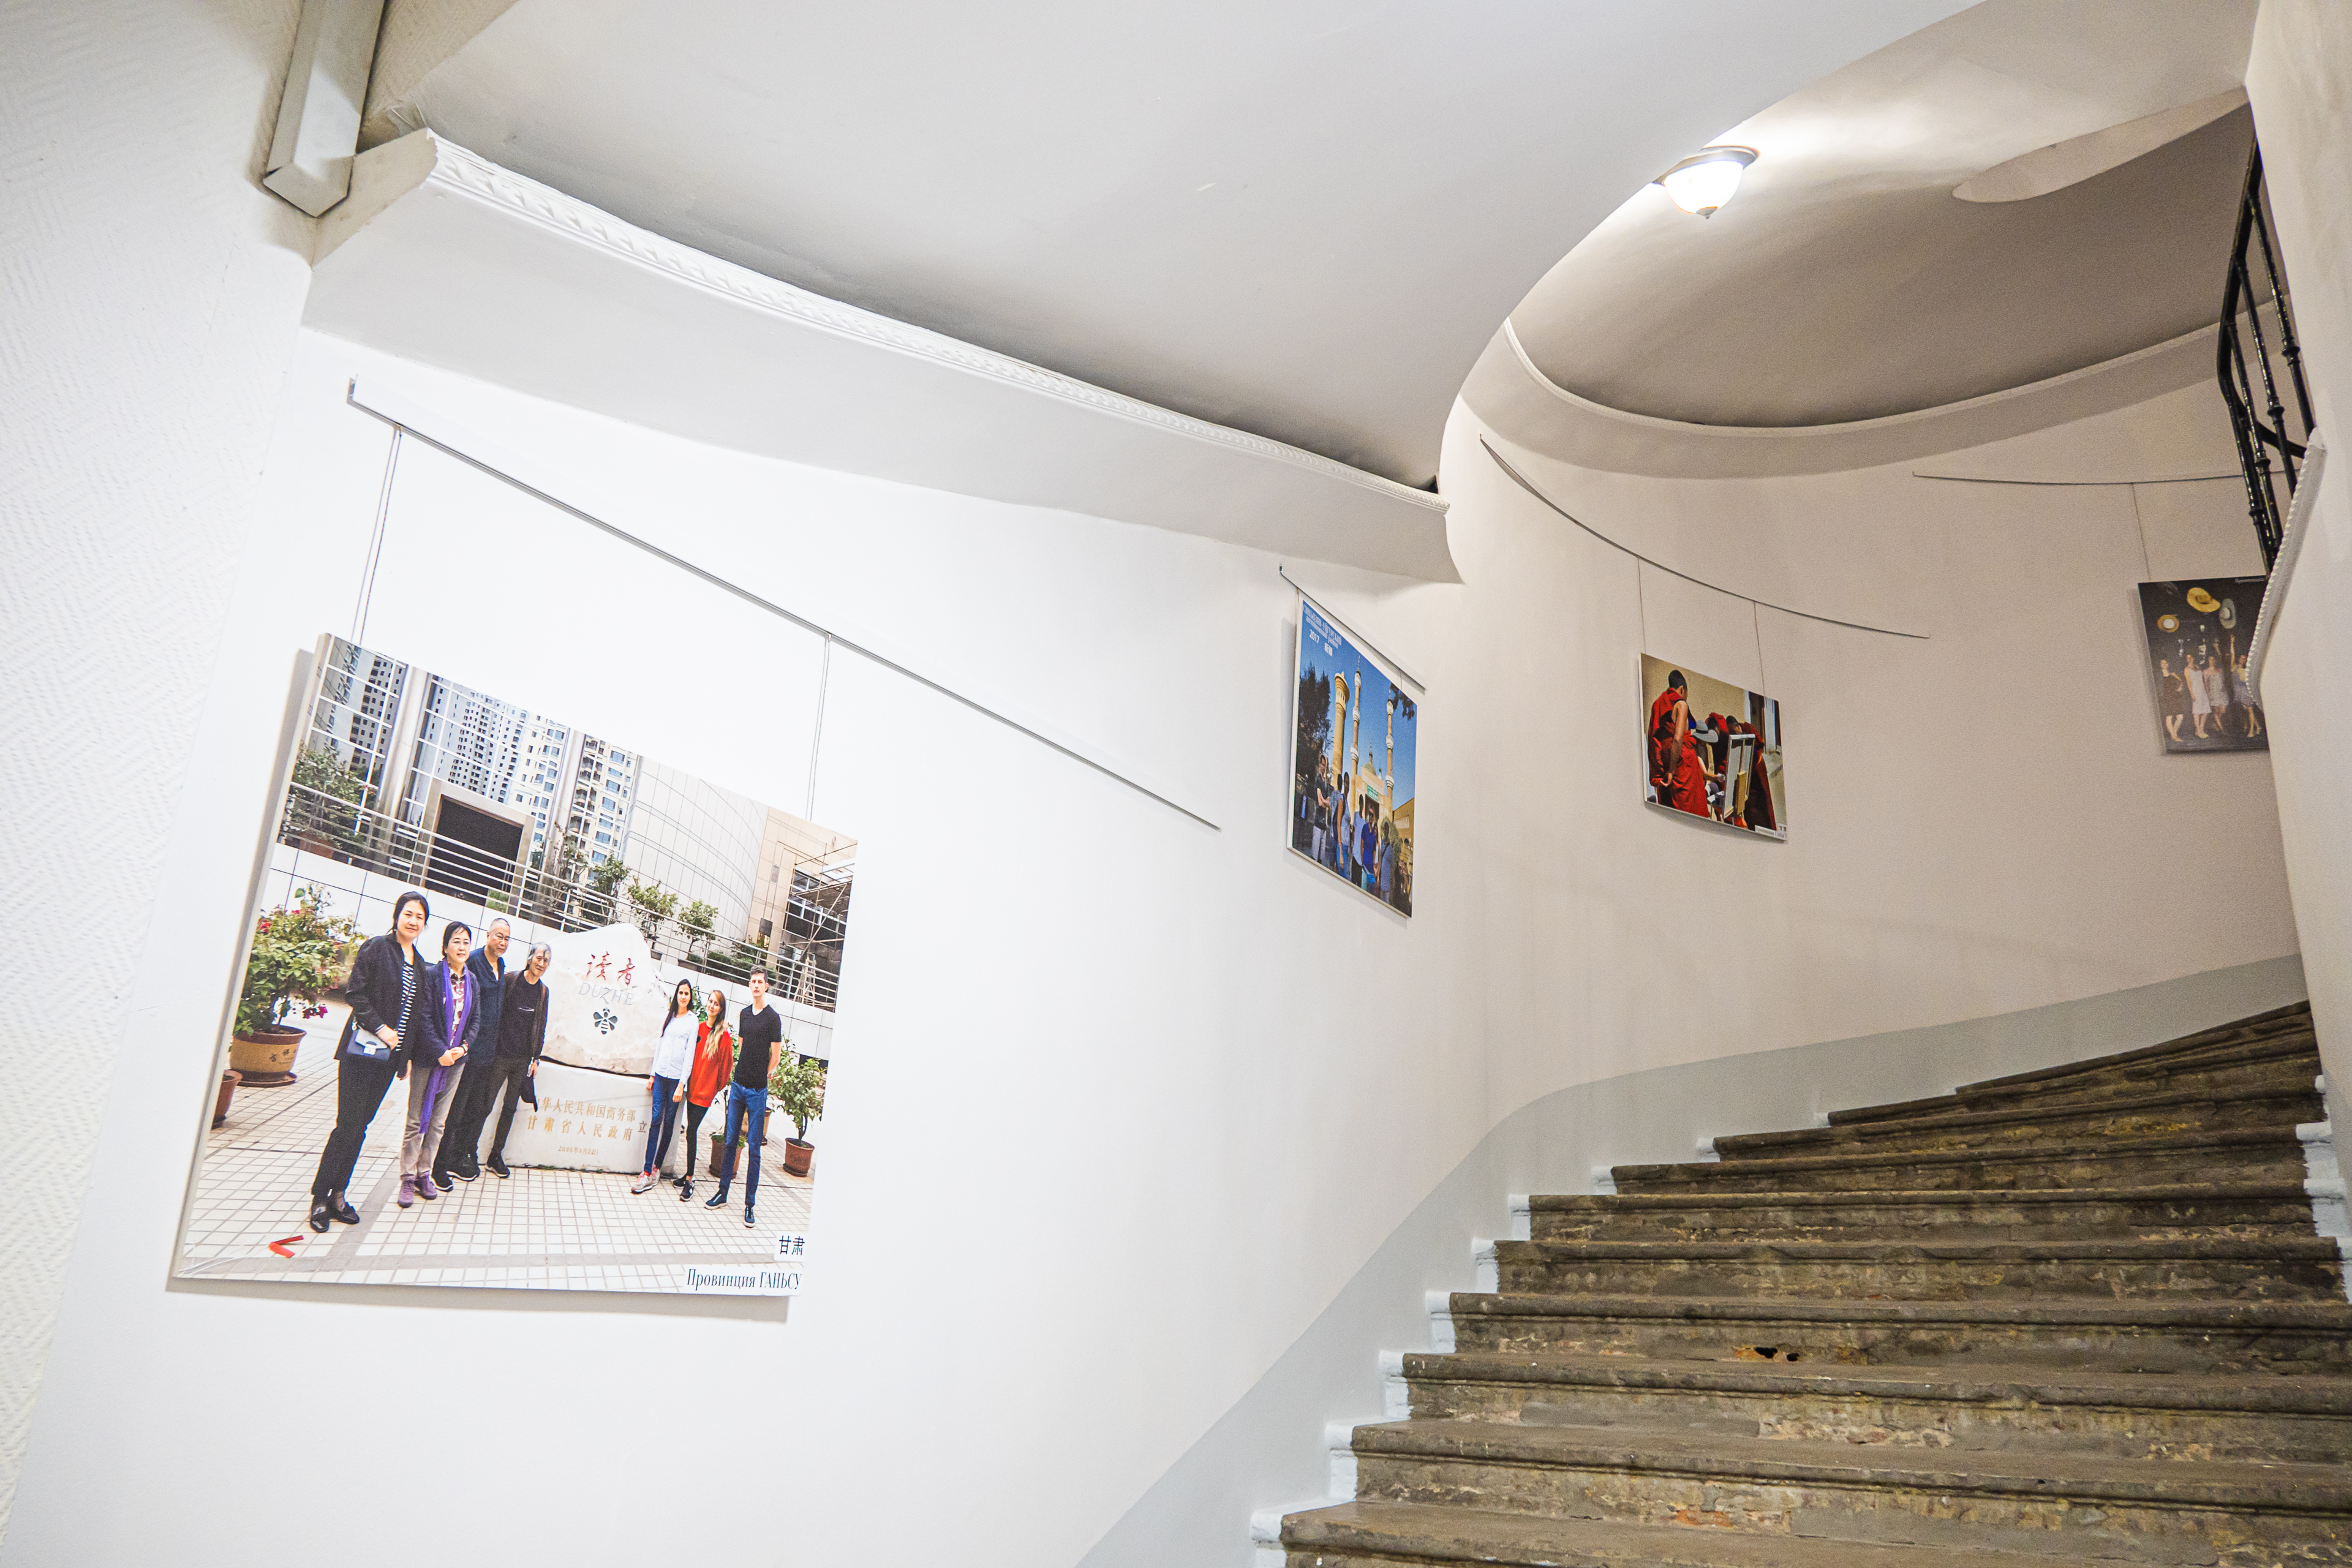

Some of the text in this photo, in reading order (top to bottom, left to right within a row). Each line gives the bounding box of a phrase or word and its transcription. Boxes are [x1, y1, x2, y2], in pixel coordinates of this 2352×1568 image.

[1310, 628, 1319, 644] 2017
[578, 982, 634, 1005] DUZHE
[779, 1235, 805, 1256] 甘肃
[687, 1268, 802, 1291] Провинция ГАНЬСУ
